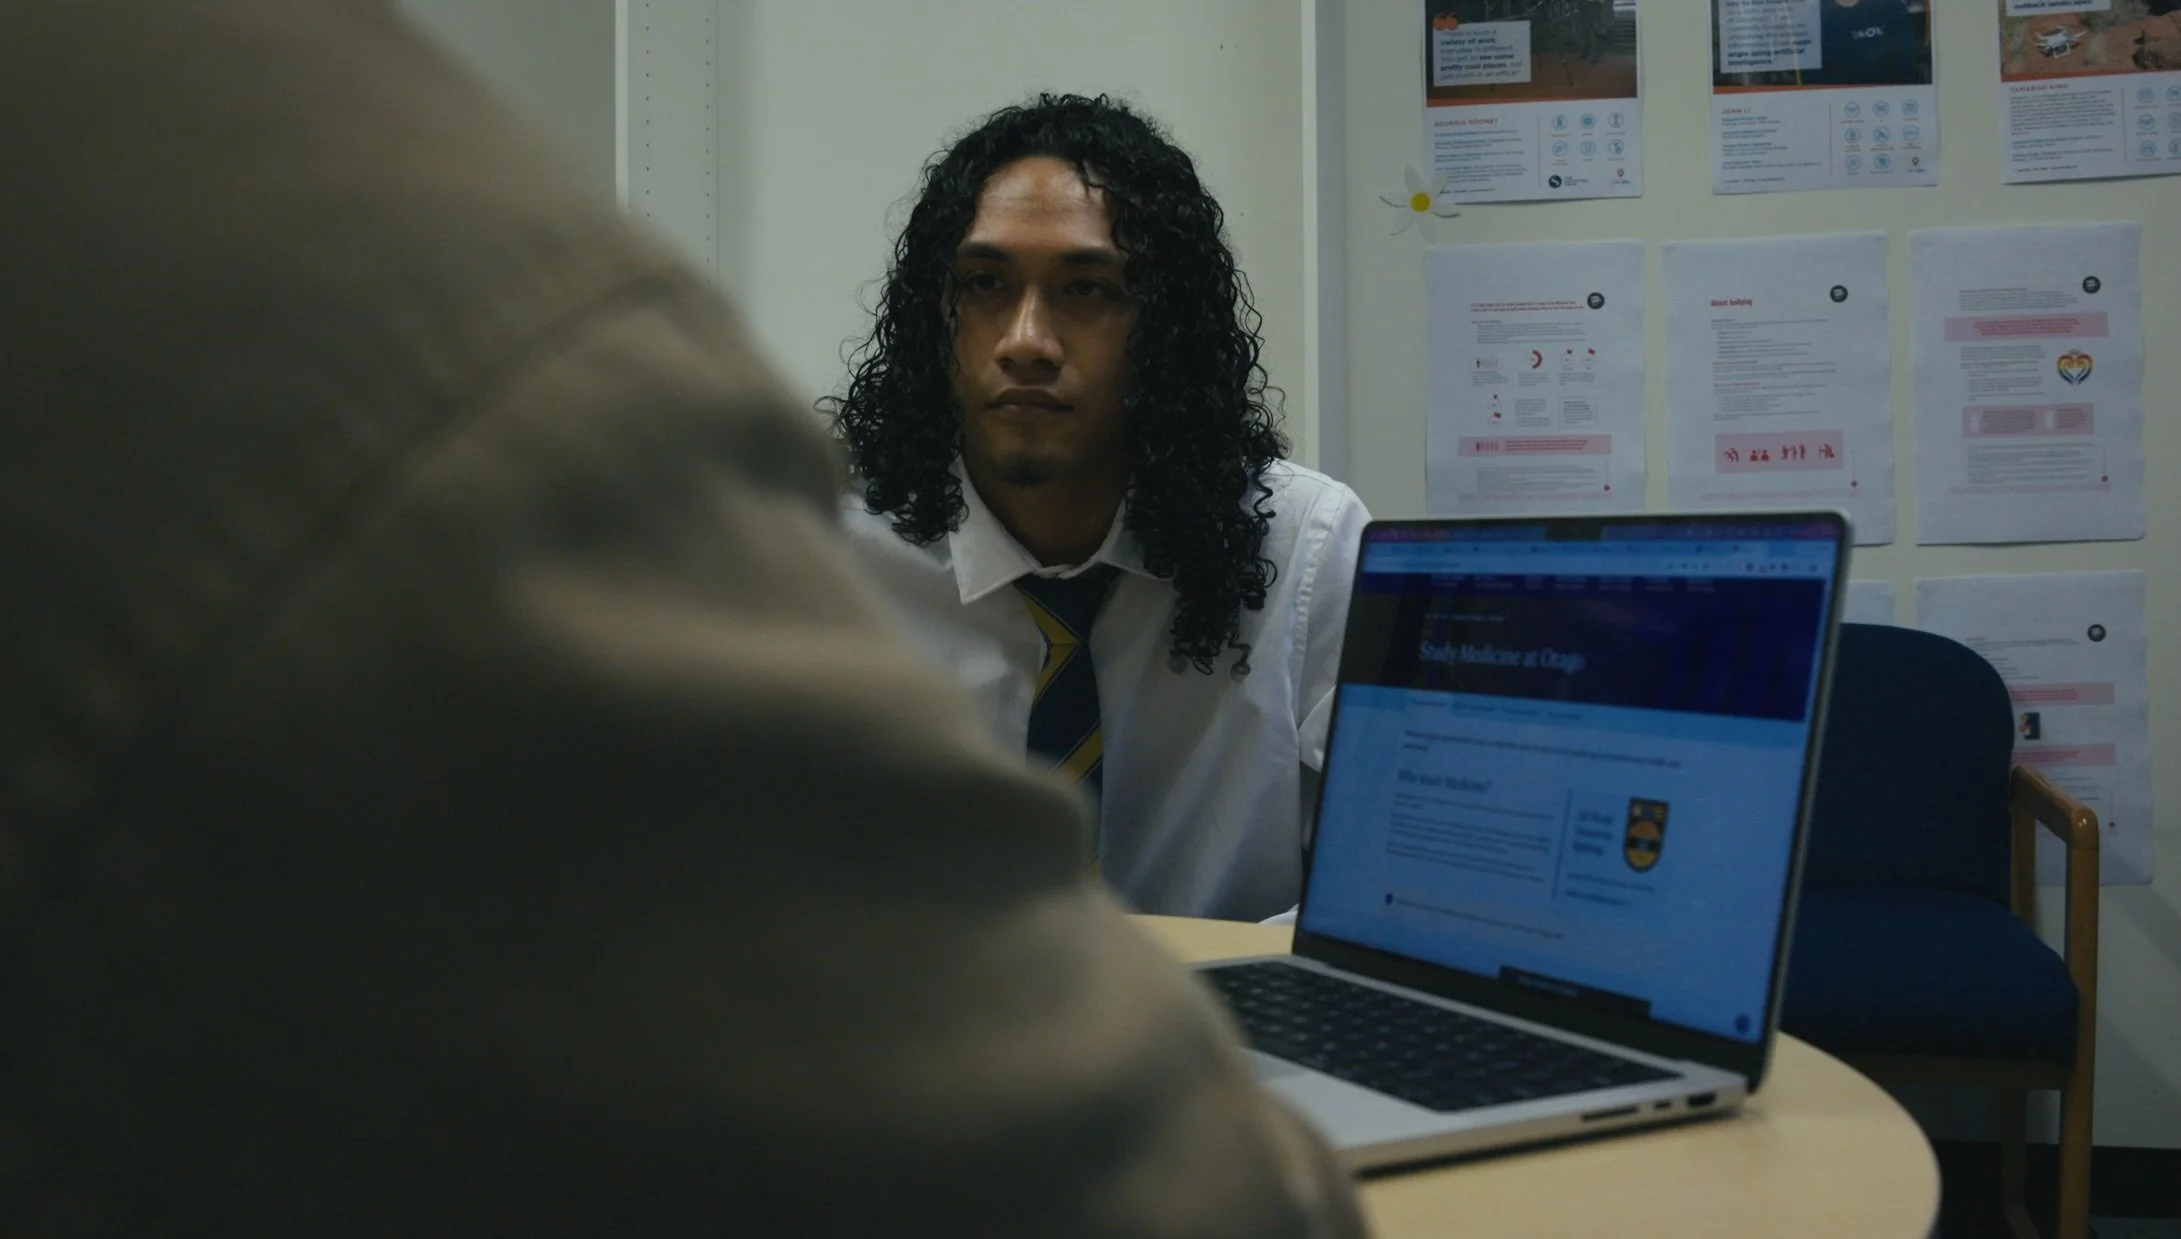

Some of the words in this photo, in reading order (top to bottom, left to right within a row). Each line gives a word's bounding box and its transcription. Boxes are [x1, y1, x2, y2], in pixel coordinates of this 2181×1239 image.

[1419, 641, 1455, 664] Study
[1460, 643, 1519, 666] Medicine
[1523, 651, 1537, 668] at
[1540, 648, 1586, 676] Otago
